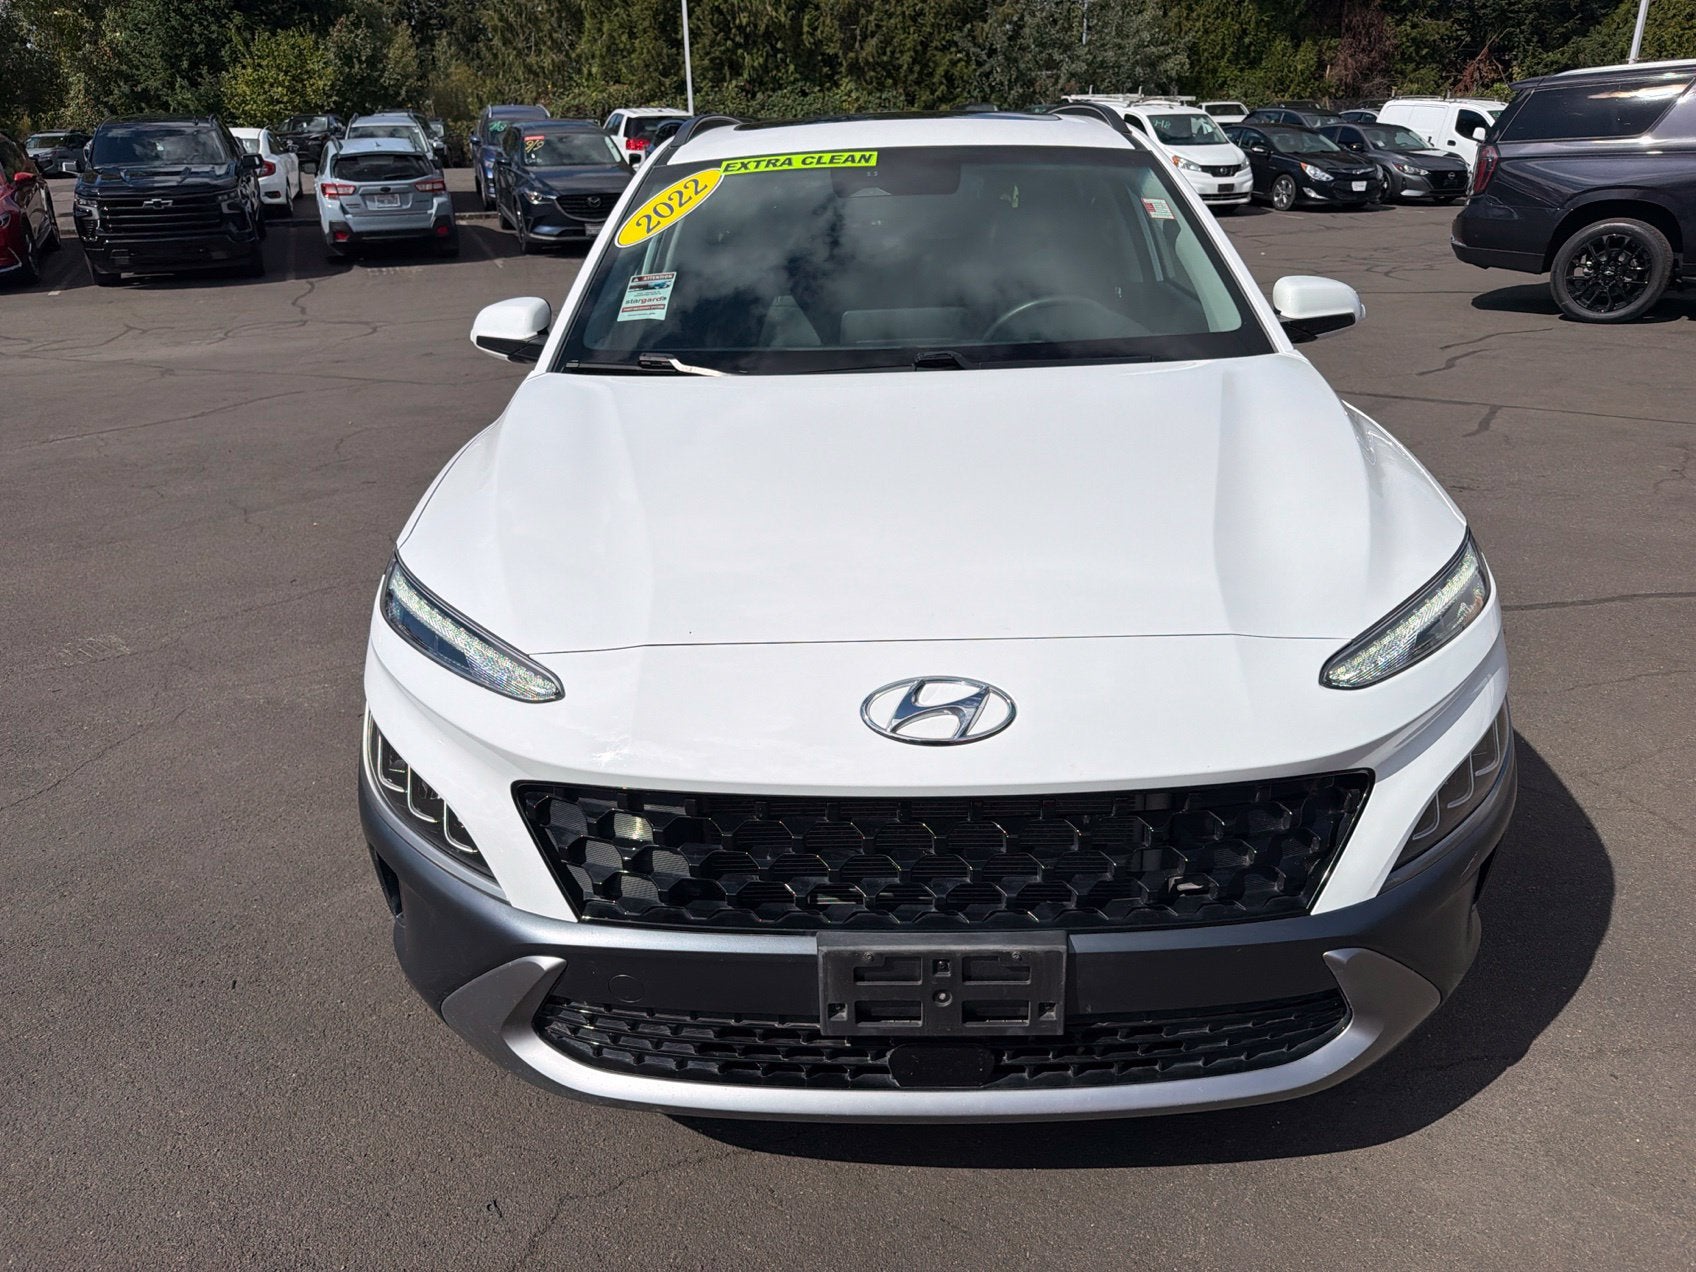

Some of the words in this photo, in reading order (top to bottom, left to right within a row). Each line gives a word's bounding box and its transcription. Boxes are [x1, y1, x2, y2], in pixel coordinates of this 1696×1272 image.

[723, 157, 793, 173] EXTRA
[801, 153, 873, 166] CLEAN
[635, 178, 708, 234] 2022
